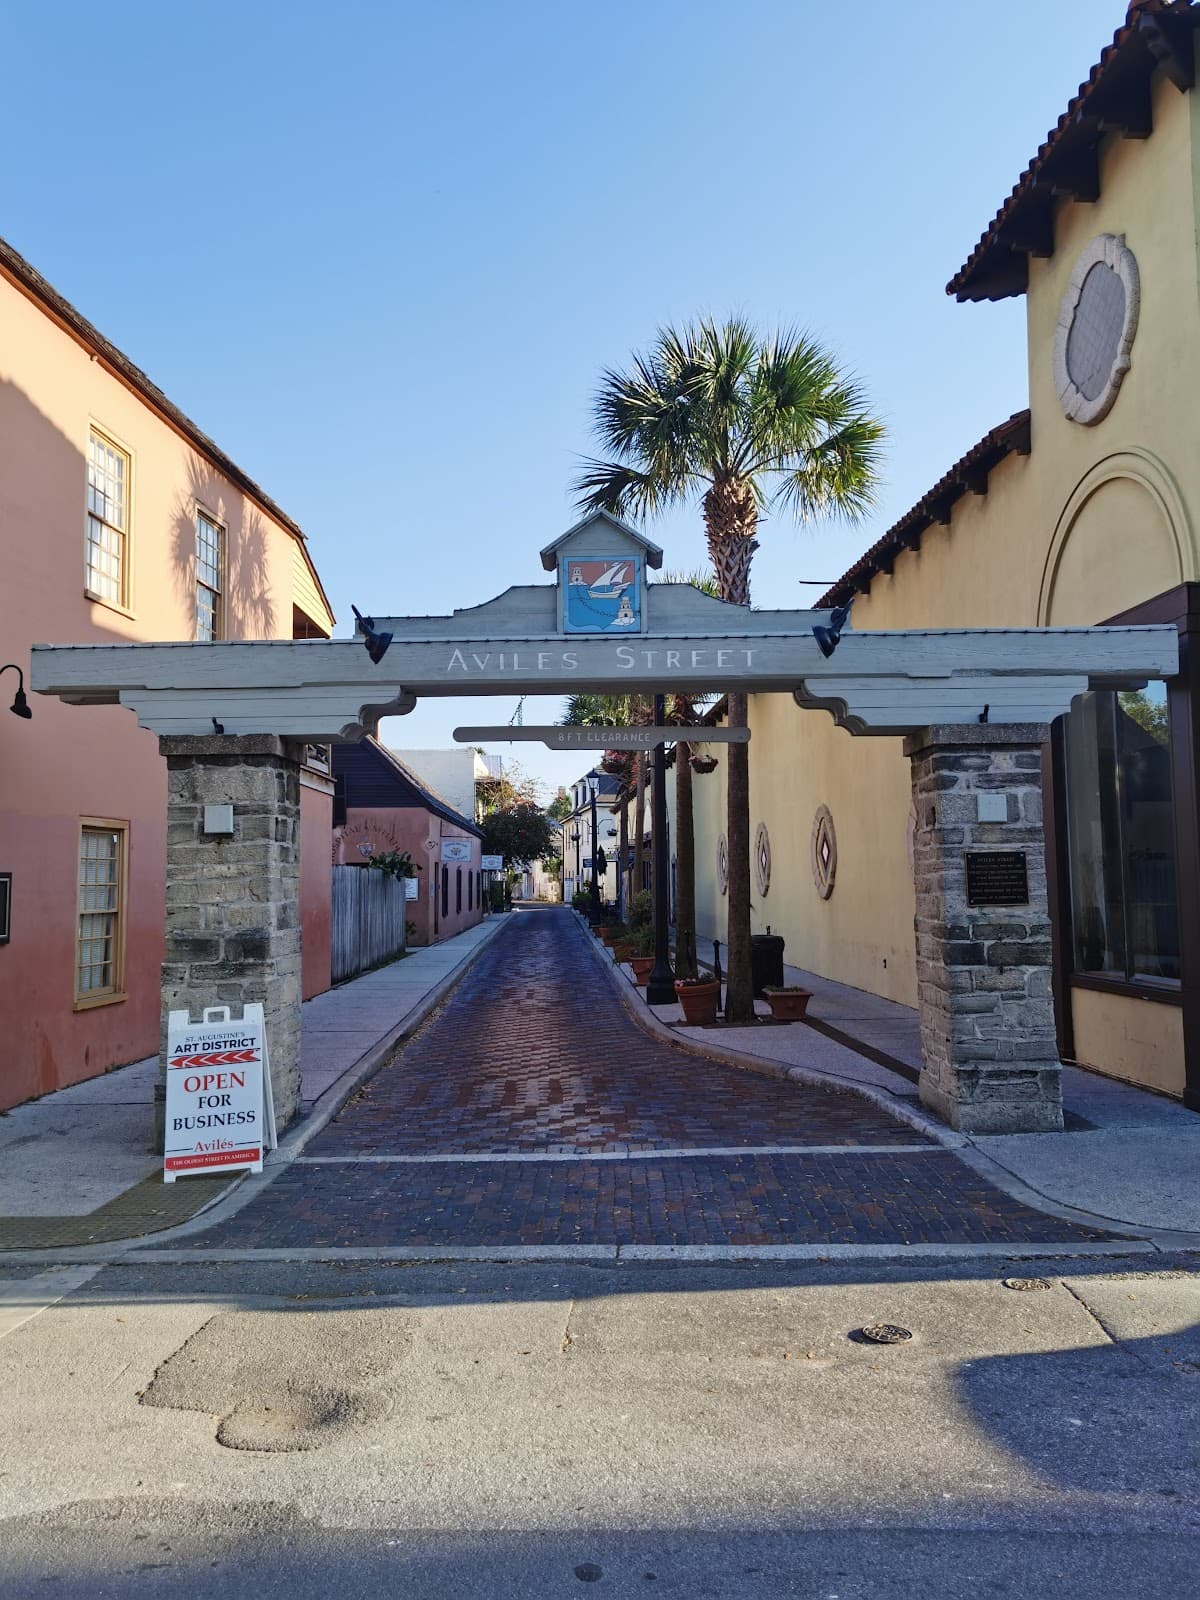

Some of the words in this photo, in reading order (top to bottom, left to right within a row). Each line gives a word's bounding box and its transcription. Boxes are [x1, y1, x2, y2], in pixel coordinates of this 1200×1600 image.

[447, 648, 578, 671] AVILES
[616, 646, 758, 669] STREET
[587, 732, 651, 742] CLEARANCE
[174, 1043, 200, 1054] ART
[202, 1037, 257, 1051] DISTRICT
[183, 1071, 245, 1093] OPEN
[198, 1094, 232, 1109] FOR
[173, 1110, 256, 1131] BUSINESS
[194, 1138, 234, 1152] Avilés
